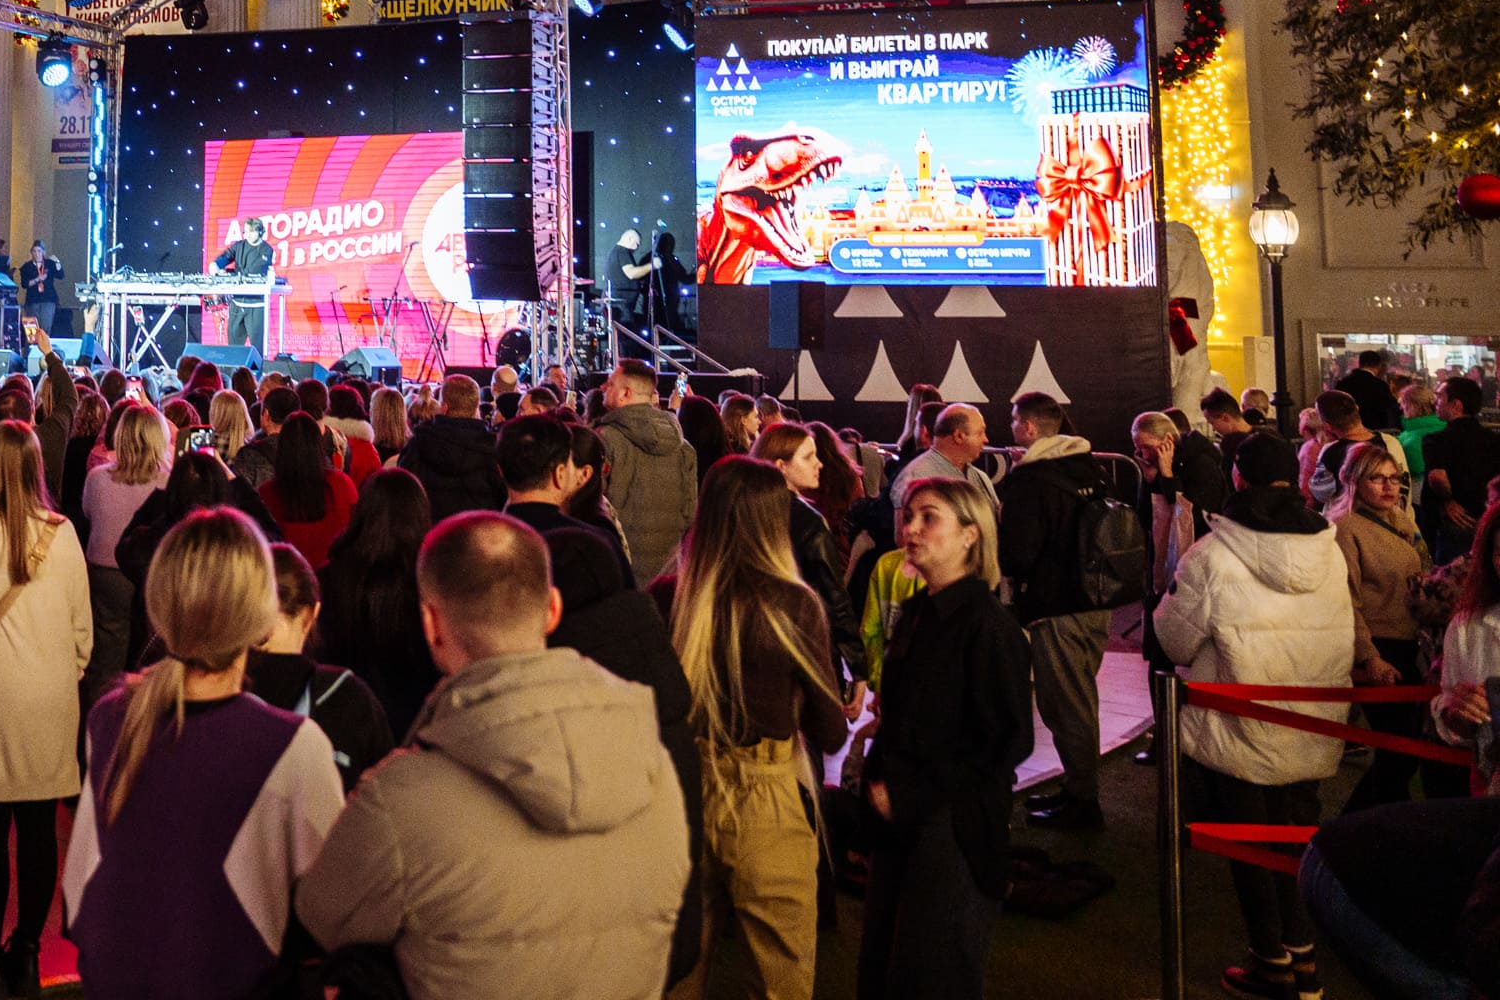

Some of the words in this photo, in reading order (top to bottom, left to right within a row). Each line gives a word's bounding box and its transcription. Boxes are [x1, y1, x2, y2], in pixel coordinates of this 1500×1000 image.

[767, 34, 847, 57] ПОКУПАЙ
[850, 35, 921, 54] БИЛЕТЫ
[924, 34, 936, 51] В
[939, 32, 989, 51] ПАРК
[830, 62, 844, 80] И
[848, 55, 940, 79] ВЫИГРАЙ
[710, 95, 757, 106] ОСТРОВ
[877, 80, 1006, 105] КВАРТИРУ!
[714, 105, 754, 117] МЕЧТЫ
[224, 199, 385, 246] АТОРАДИО
[309, 231, 403, 264] РОССИИ
